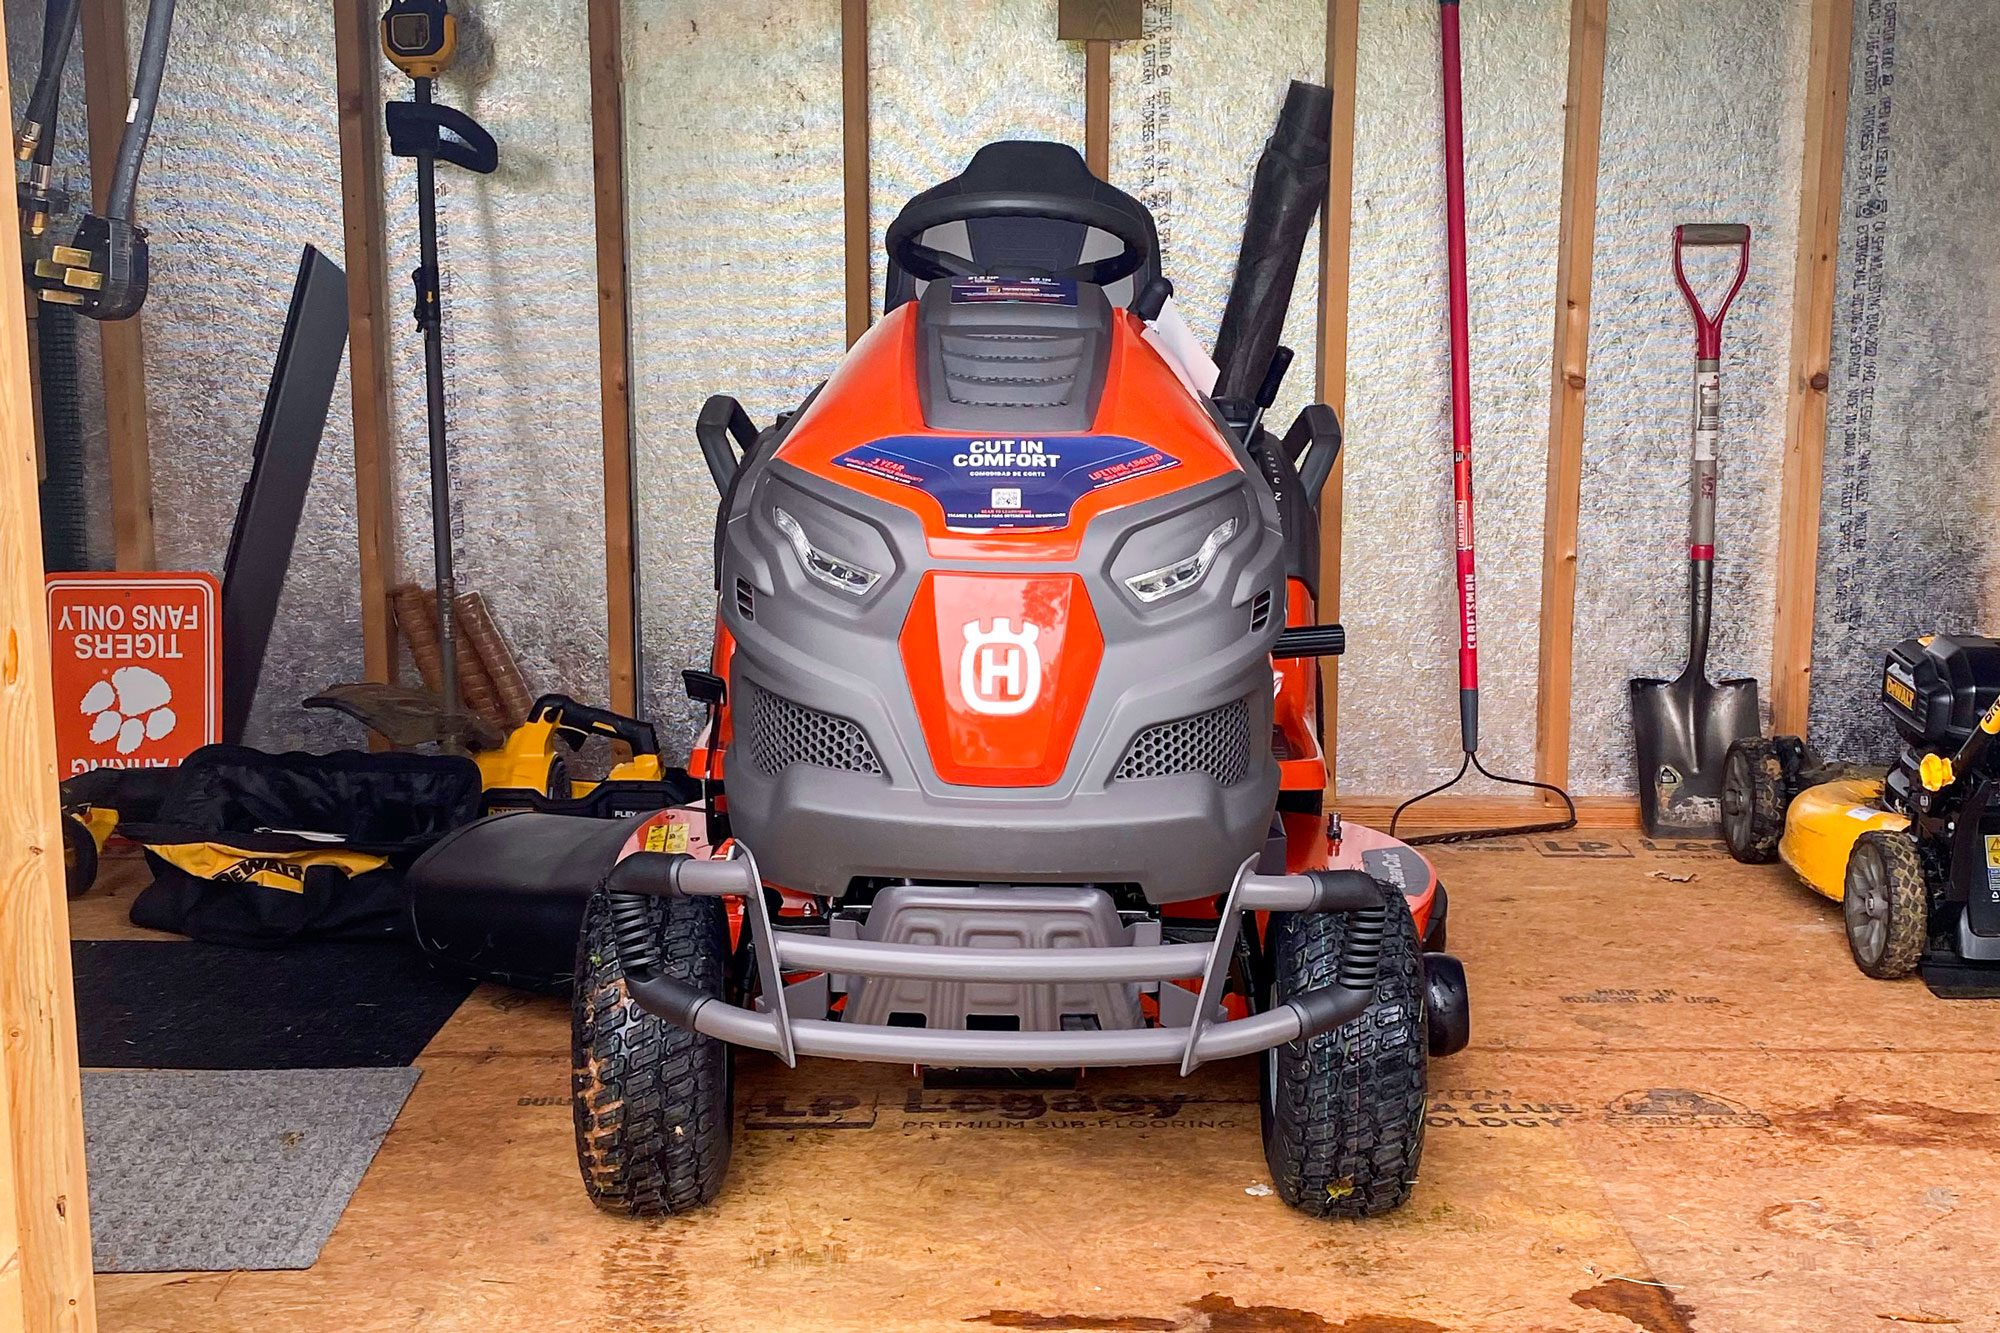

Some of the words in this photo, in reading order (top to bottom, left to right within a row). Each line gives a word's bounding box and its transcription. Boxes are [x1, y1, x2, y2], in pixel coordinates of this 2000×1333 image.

[969, 440, 1016, 454] CUT
[1020, 440, 1044, 454] IN
[880, 458, 905, 472] YEAR
[952, 453, 1061, 468] COMFORT
[1702, 472, 1714, 500] ACE
[1457, 502, 1465, 548] CRAFTSMAN
[57, 604, 125, 631] ONLY
[132, 604, 198, 630] FANS
[1465, 574, 1477, 650] CRAFTSMAN
[74, 633, 184, 660] TIGERS
[1543, 840, 1613, 852] LP
[765, 1095, 861, 1117] LP
[904, 1087, 1186, 1119] Legacy
[1471, 1103, 1583, 1114] GLUE
[902, 1121, 1025, 1129] PREMIUM
[1035, 1121, 1239, 1129] SUB-FLOORING
[1425, 1117, 1566, 1128] OLOGY
